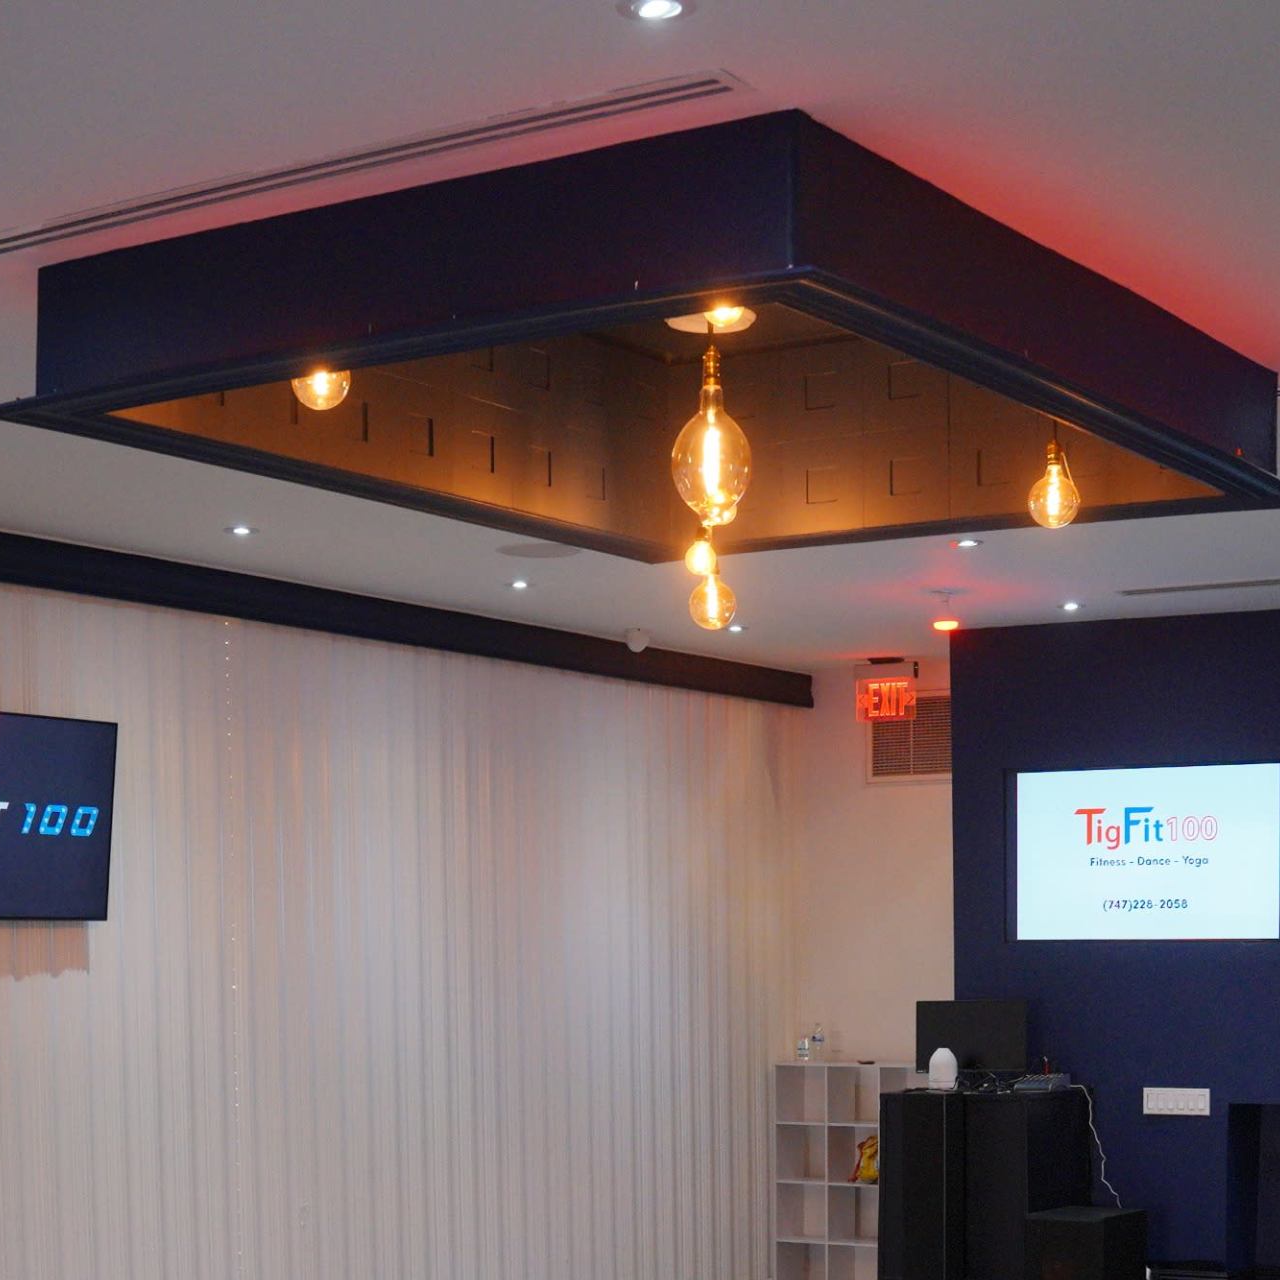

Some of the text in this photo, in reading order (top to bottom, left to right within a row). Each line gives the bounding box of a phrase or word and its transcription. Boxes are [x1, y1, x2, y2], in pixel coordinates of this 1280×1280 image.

[868, 682, 908, 717] EXIT
[21, 802, 99, 836] 100
[1090, 857, 1126, 866] Fitness
[1137, 856, 1171, 866] Dance
[1182, 856, 1209, 867] Yoga
